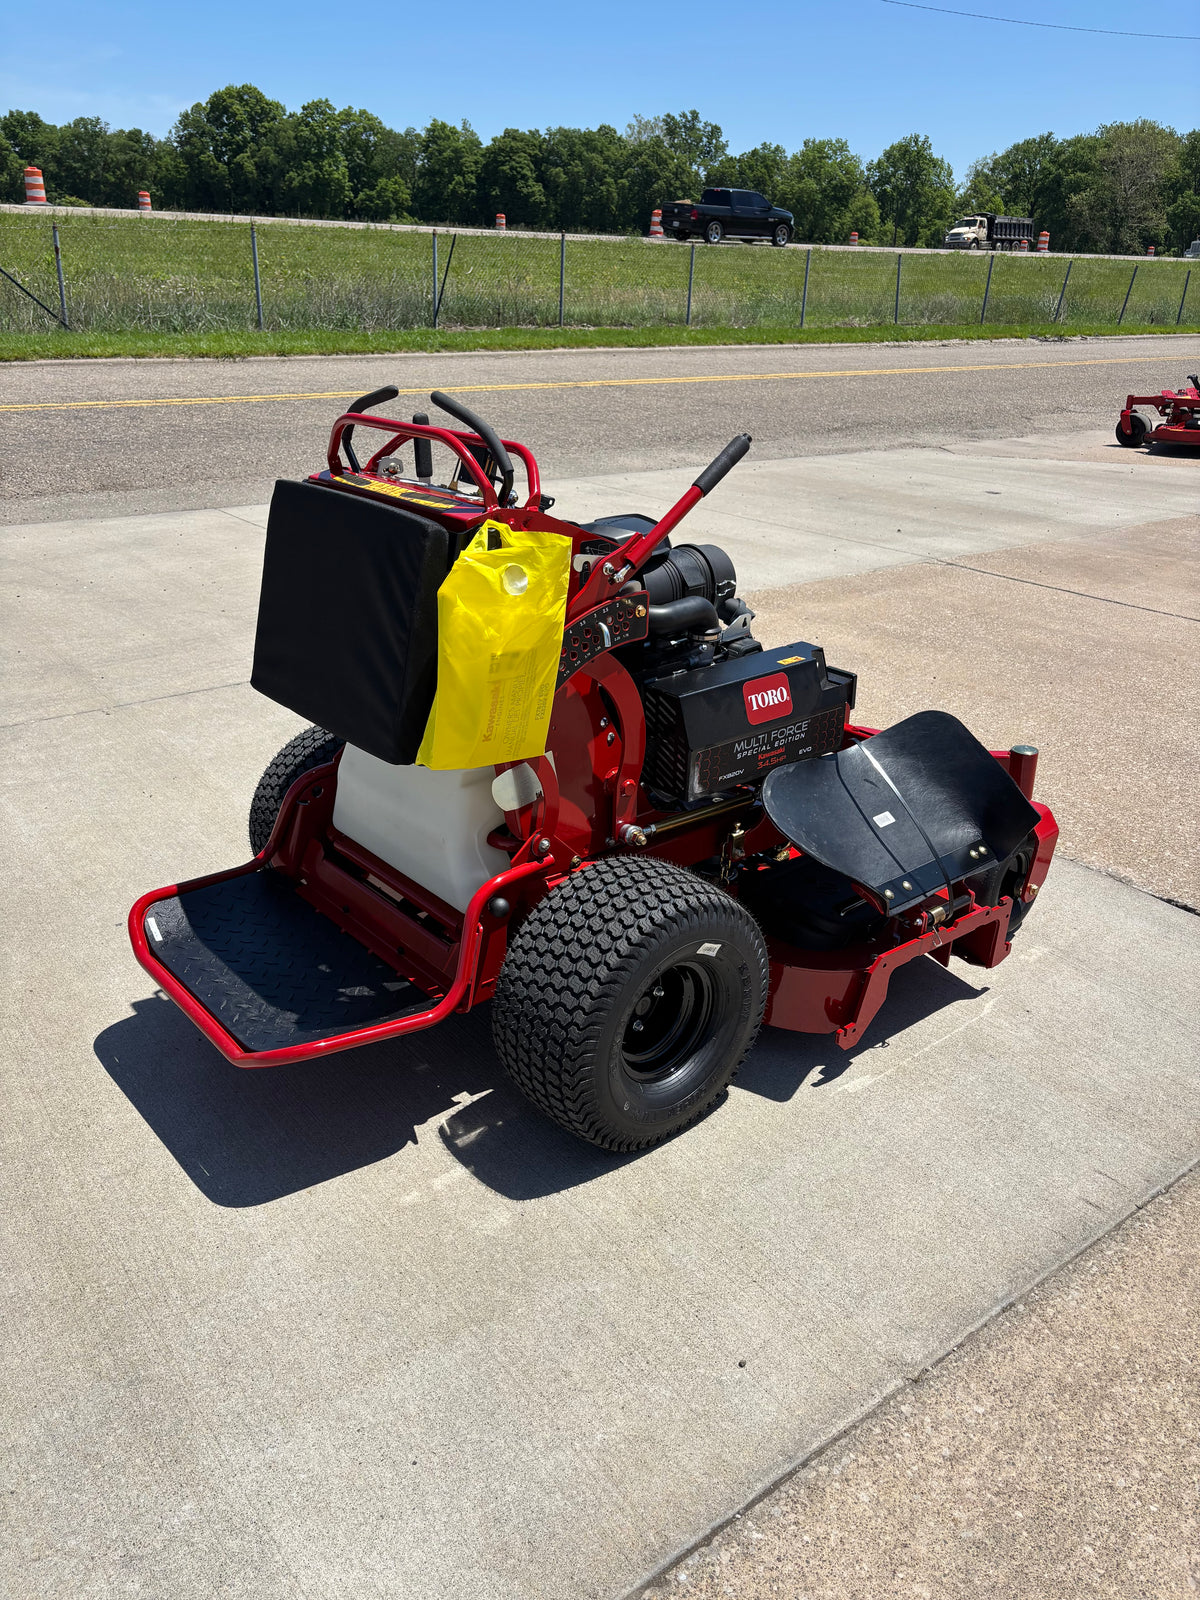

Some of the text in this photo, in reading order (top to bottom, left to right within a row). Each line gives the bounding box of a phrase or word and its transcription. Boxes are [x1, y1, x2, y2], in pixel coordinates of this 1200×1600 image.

[481, 680, 501, 743] Kawasaki
[748, 686, 787, 711] TORO
[733, 721, 809, 753] MULTI FORCE
[736, 732, 806, 760] SPECIAL EDITION
[757, 746, 785, 760] Kawasaki
[798, 746, 812, 755] EVO
